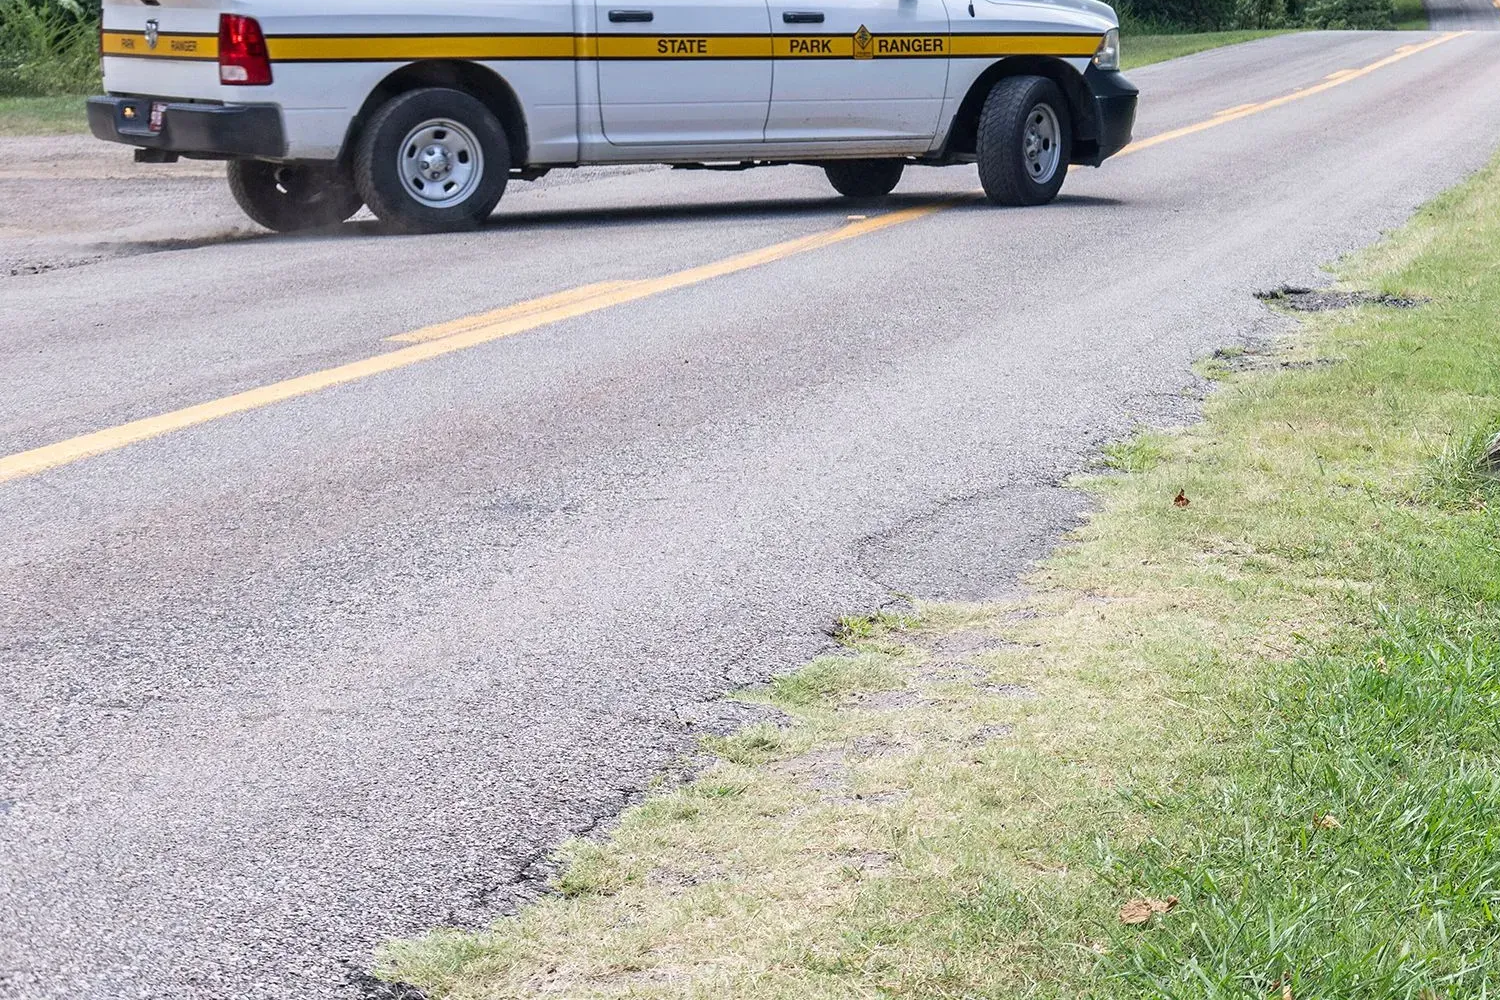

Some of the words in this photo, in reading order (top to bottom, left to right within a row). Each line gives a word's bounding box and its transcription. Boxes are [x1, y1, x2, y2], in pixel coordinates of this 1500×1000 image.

[121, 38, 136, 49] PARK
[170, 40, 198, 52] RANGER
[657, 39, 708, 54] STATE
[789, 39, 832, 54] PARK
[878, 38, 944, 53] RANGER
